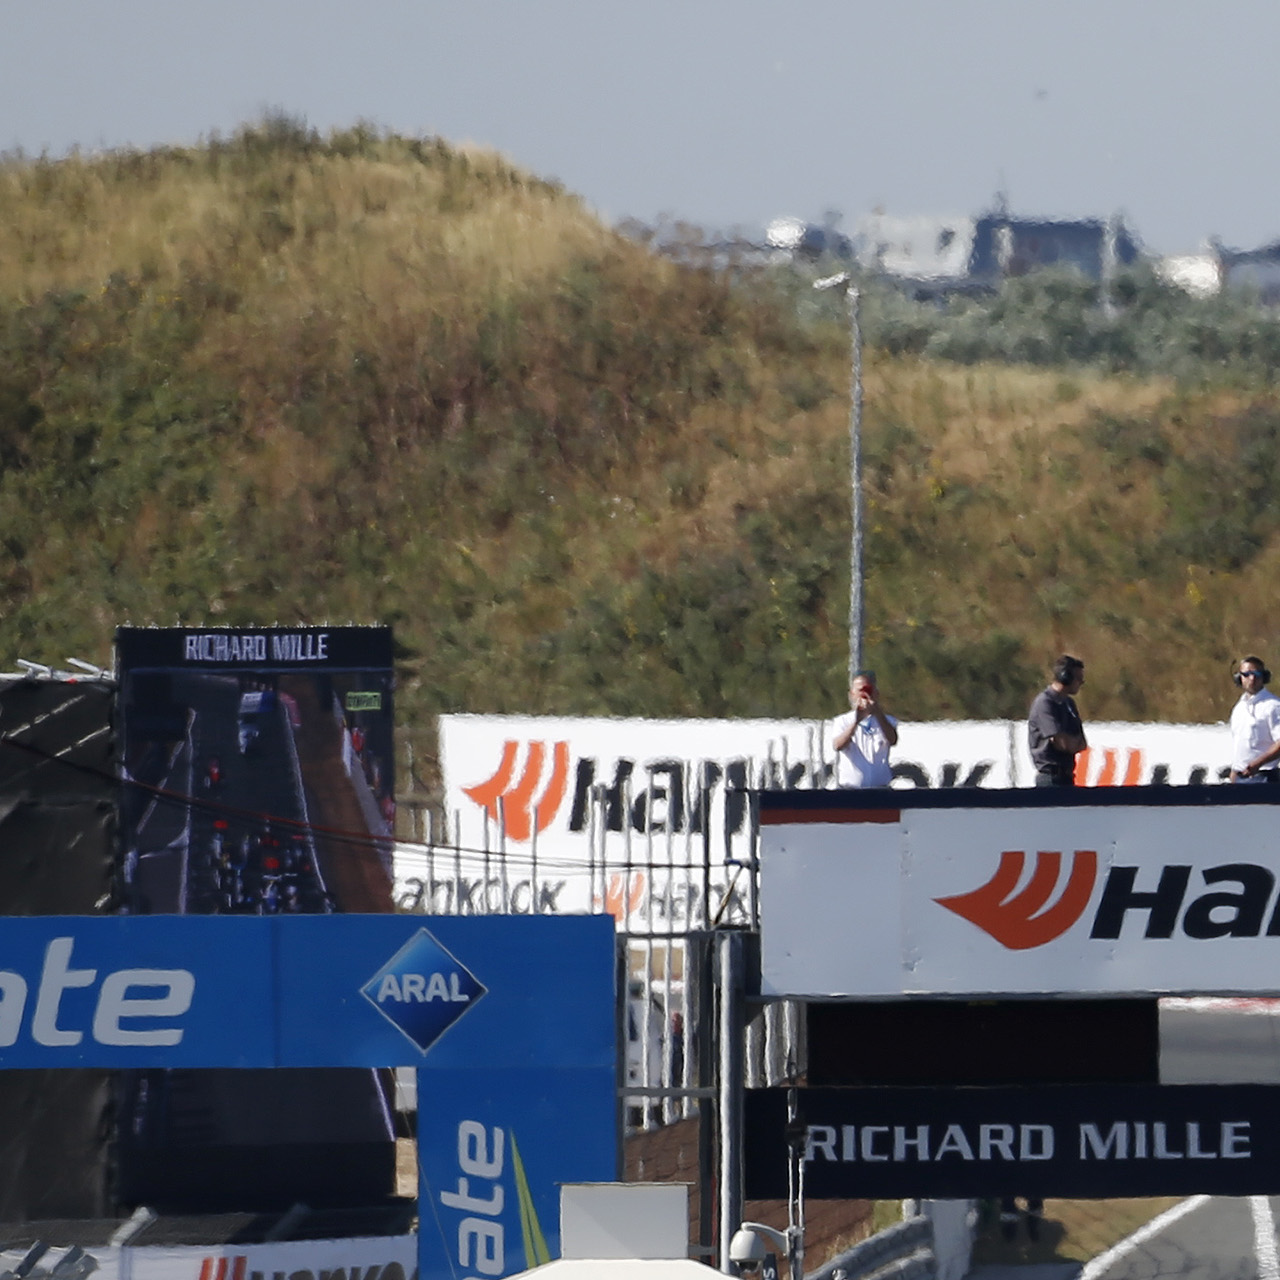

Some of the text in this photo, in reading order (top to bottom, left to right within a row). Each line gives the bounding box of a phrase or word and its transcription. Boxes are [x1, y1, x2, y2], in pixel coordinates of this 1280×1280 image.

[184, 633, 330, 661] RICHARD MILLE
[377, 973, 470, 1003] ARAL
[802, 1121, 1252, 1162] RICHARD MILLE
